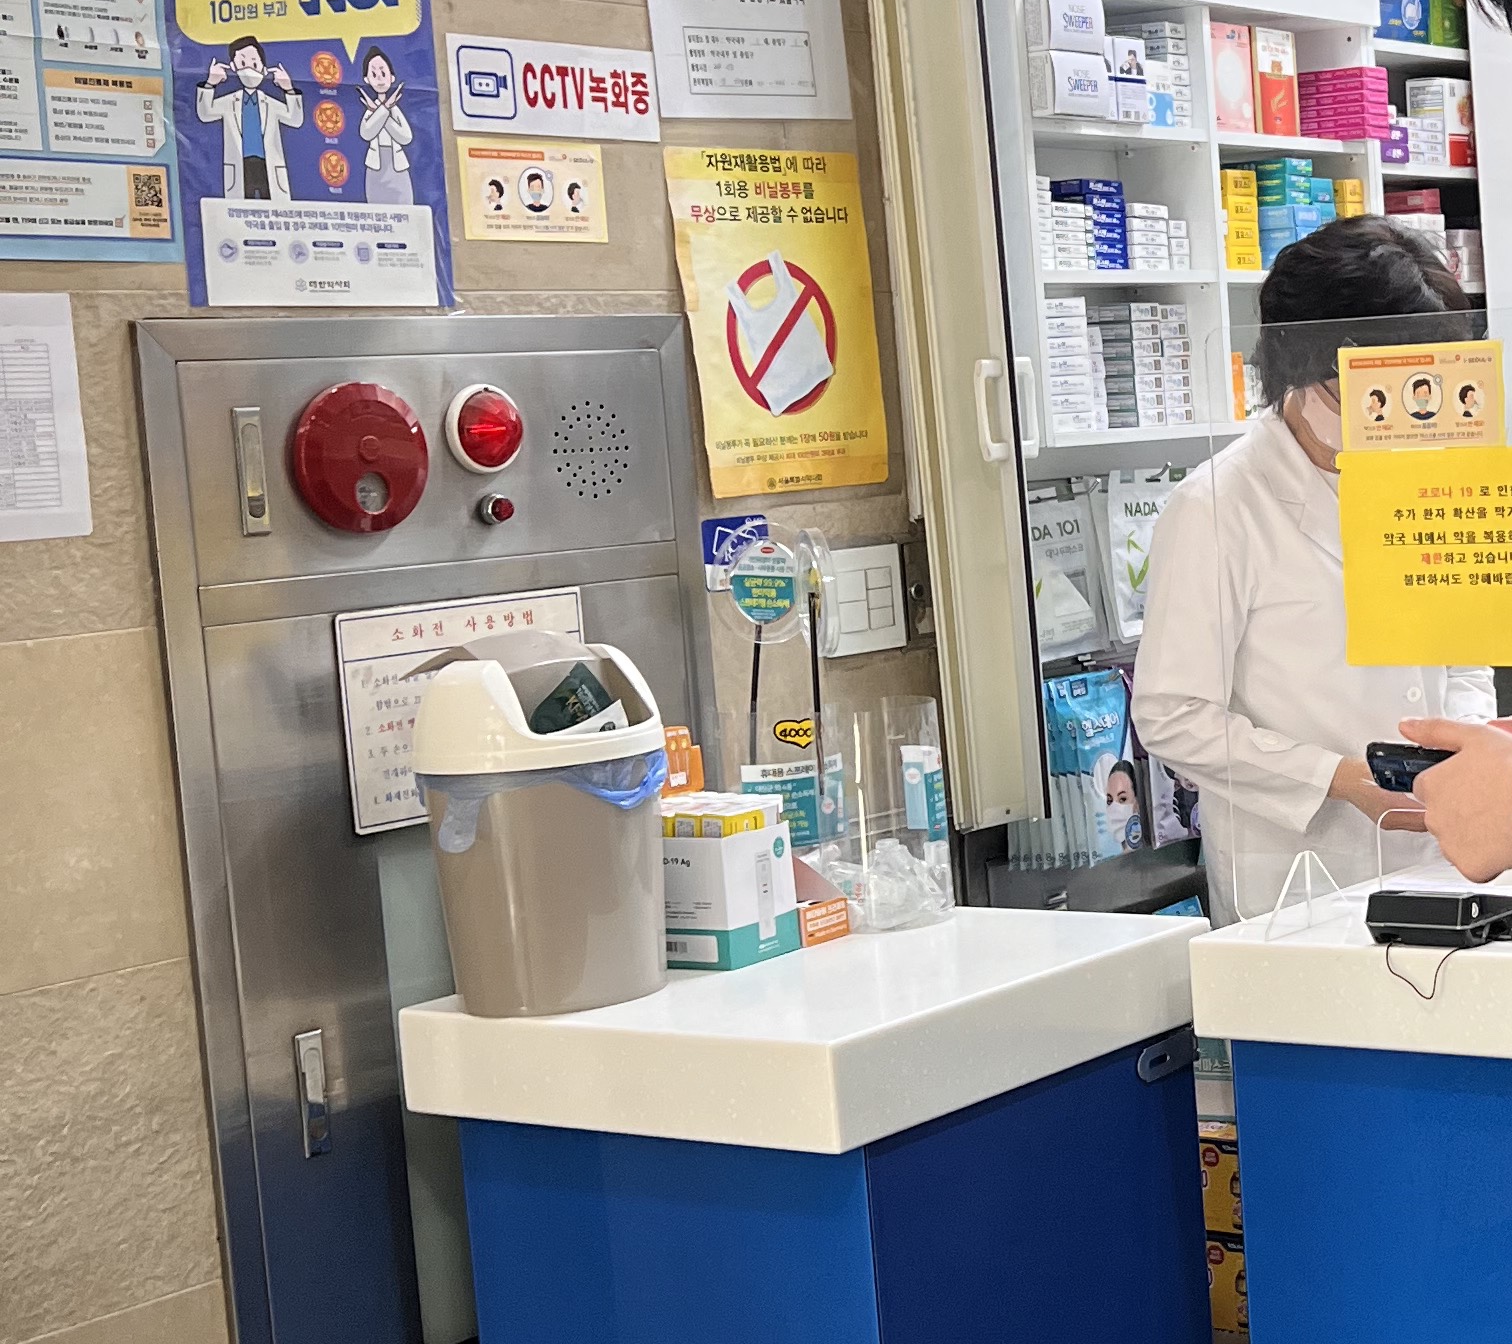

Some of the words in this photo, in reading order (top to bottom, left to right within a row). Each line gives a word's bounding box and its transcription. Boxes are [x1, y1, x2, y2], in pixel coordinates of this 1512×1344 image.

[209, 0, 259, 24] 10만원
[263, 1, 288, 18] 부과
[1063, 13, 1093, 29] SWEEPER
[1067, 76, 1098, 93] SWEEPER
[803, 156, 827, 174] 따라
[716, 180, 749, 199] 1회용
[754, 181, 815, 199] 비닐봉투를
[691, 205, 742, 223] 무상으로
[746, 205, 783, 224] 제공할
[786, 207, 798, 223] 수
[801, 206, 848, 224] 없습니다
[1418, 486, 1453, 499] 코로나
[1459, 487, 1473, 497] 19
[1479, 485, 1491, 497] 로
[1124, 502, 1159, 517] NADA
[1393, 508, 1416, 521] 추가
[1423, 508, 1446, 520] 환자
[1453, 506, 1487, 519] 확산을
[1056, 519, 1081, 537] 101
[1383, 532, 1406, 545] 약국
[1413, 531, 1447, 544] 내에서
[1453, 531, 1476, 544] 약을
[1421, 552, 1467, 565] 제한하고
[392, 620, 444, 641] 소화전
[465, 609, 534, 632] 사용방법
